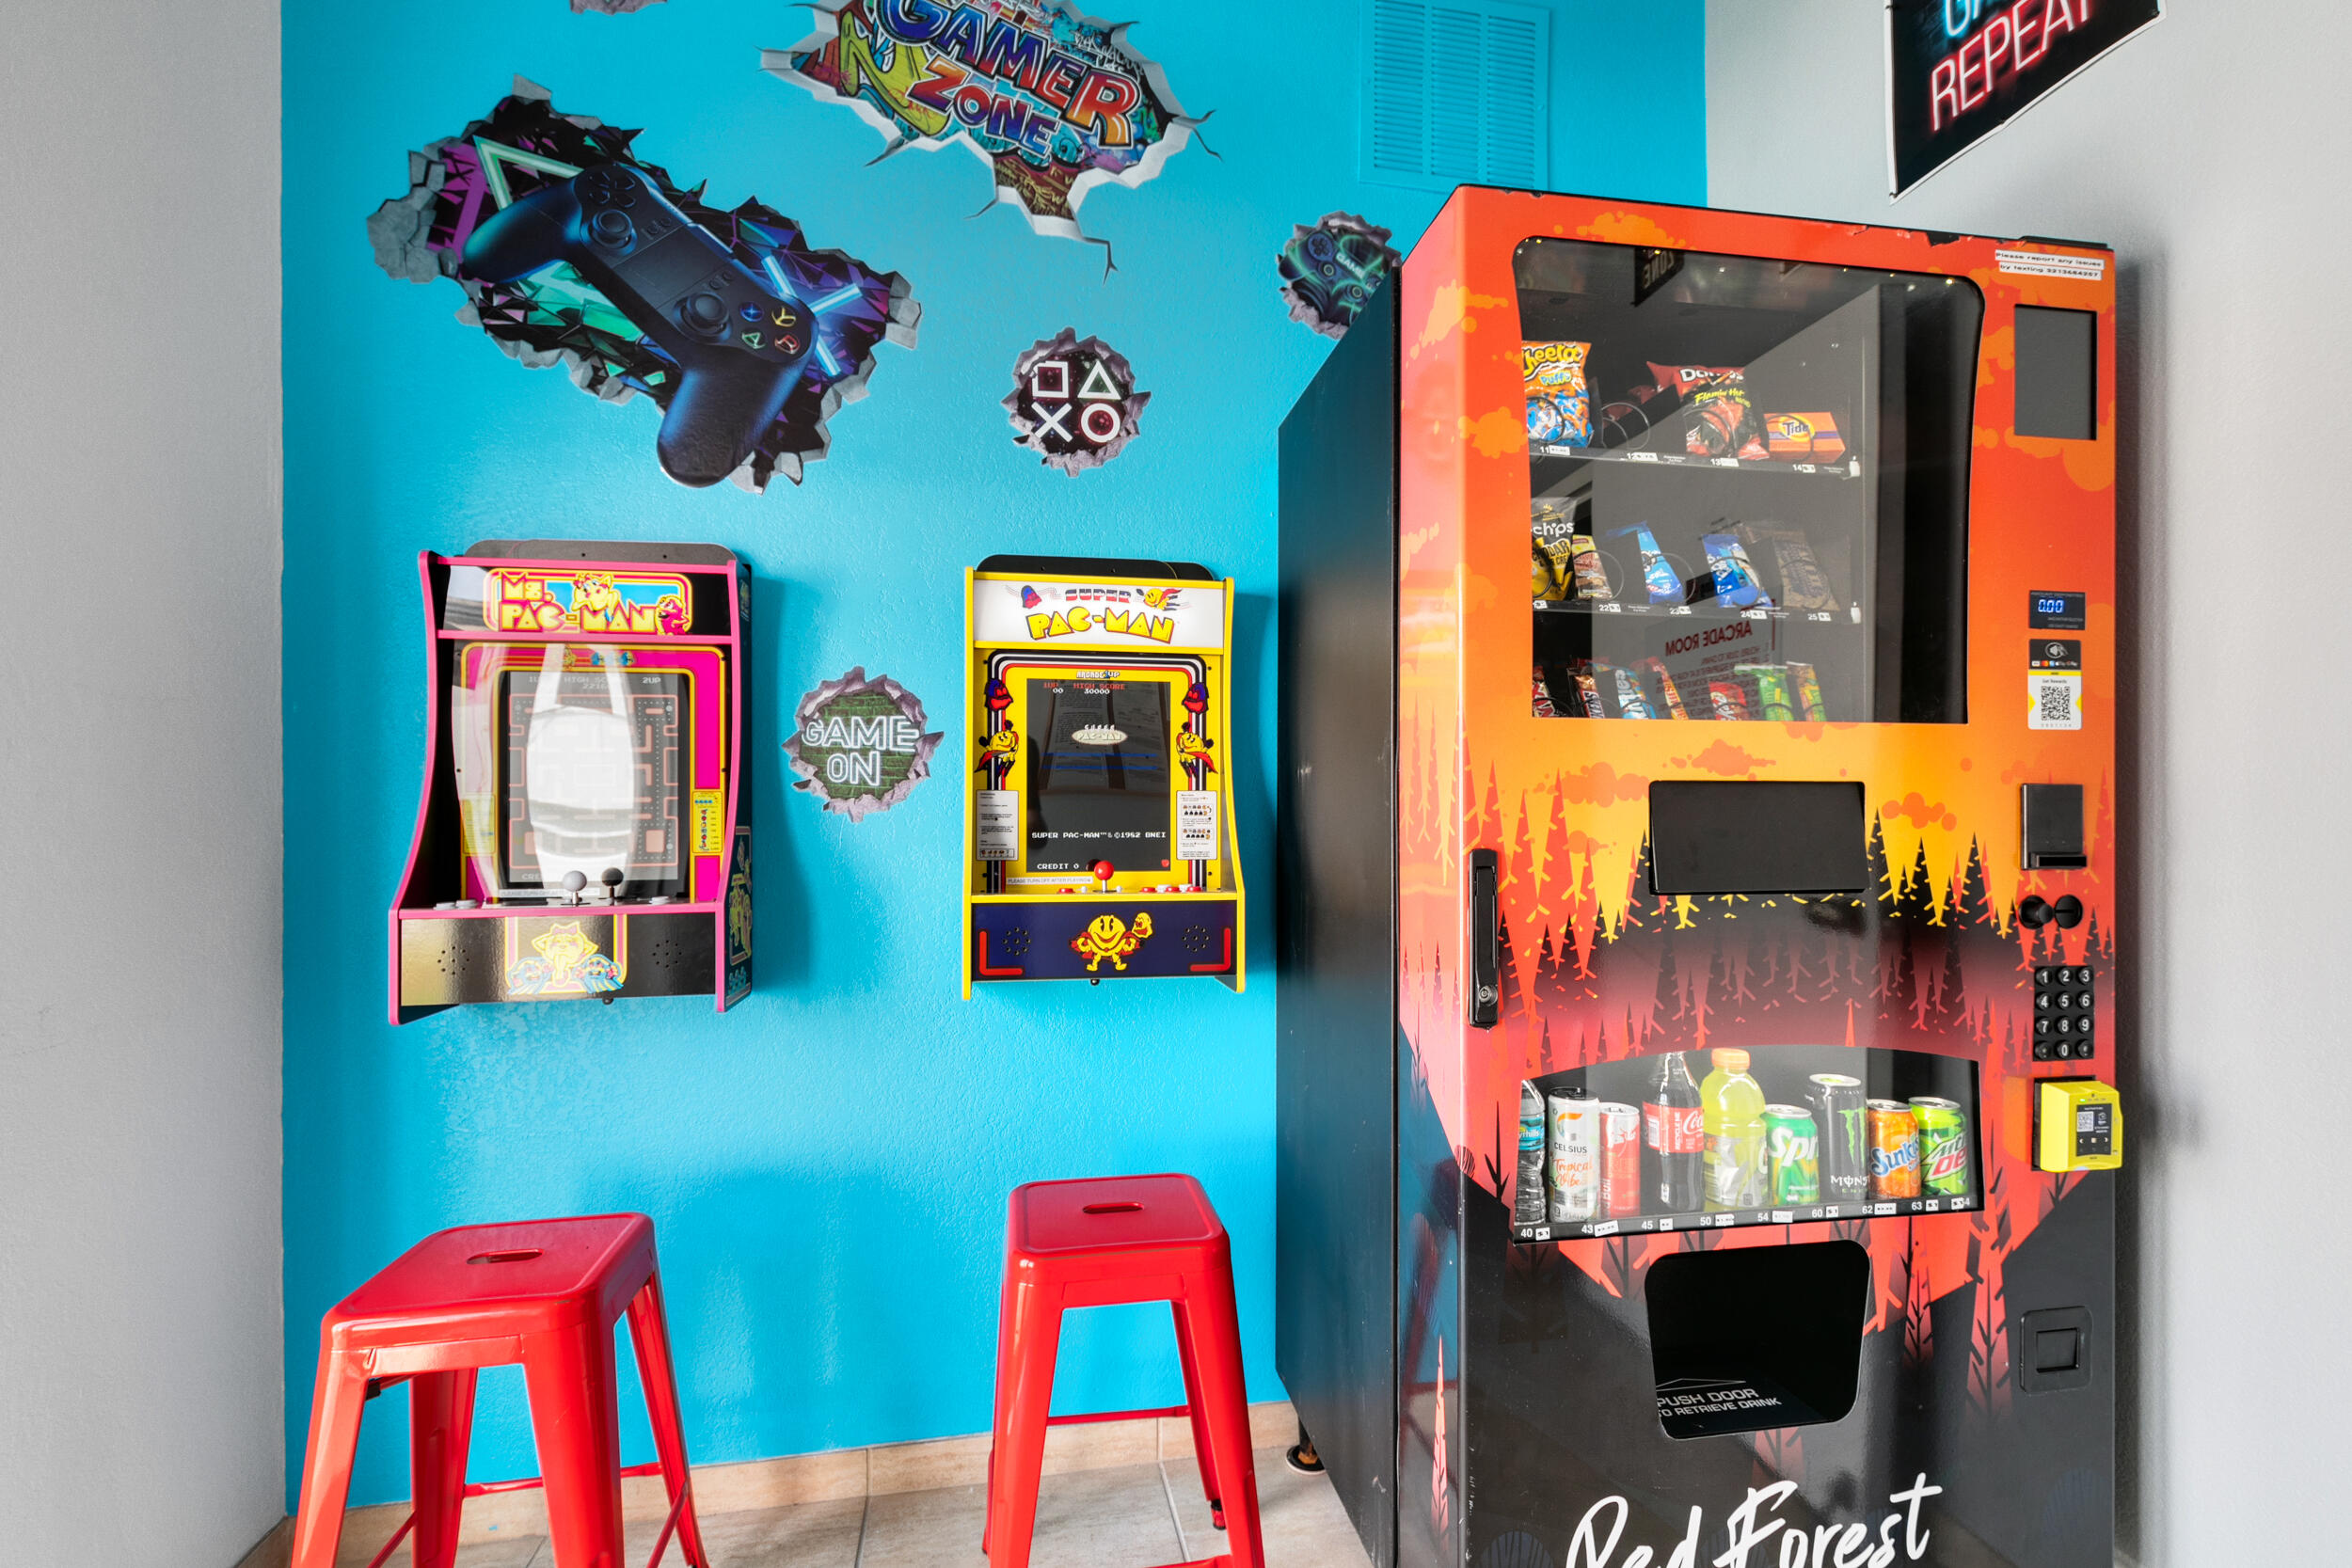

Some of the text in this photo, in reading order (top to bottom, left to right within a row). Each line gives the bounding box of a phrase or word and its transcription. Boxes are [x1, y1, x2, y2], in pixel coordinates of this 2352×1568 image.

[875, 0, 1140, 150] GAMER
[906, 55, 1060, 159] ZONE
[1531, 522, 1575, 537] chips
[501, 571, 554, 604] MS.
[1064, 588, 1132, 604] SUPER
[499, 600, 658, 633] PAC-MAN
[1025, 605, 1176, 644] PAC-MAN
[802, 715, 919, 752] GAME
[827, 751, 881, 787] ON
[2041, 970, 2090, 984] 1 2 3
[2040, 994, 2090, 1008] 4 5 6
[2041, 1019, 2090, 1034] 7 8 9
[2060, 1044, 2069, 1056] 0
[1553, 1142, 1588, 1154] CELSIUS
[1769, 1126, 1819, 1167] Spr
[1552, 1154, 1594, 1175] Tropical
[1931, 1146, 1968, 1177] DE
[1812, 1209, 1823, 1218] 60
[1862, 1205, 1873, 1214] 62
[1911, 1201, 1922, 1211] 63
[1700, 1216, 1711, 1227] 50
[1757, 1212, 1769, 1222] 54
[1520, 1227, 1533, 1238] 40
[1581, 1224, 1594, 1234] 43
[1642, 1220, 1653, 1230] 45
[1656, 1388, 1759, 1408] PUSH DOOR
[1676, 1402, 1738, 1416] RETRIEVE
[1738, 1397, 1782, 1409] DRINK
[1712, 1472, 1943, 1568] Forest
